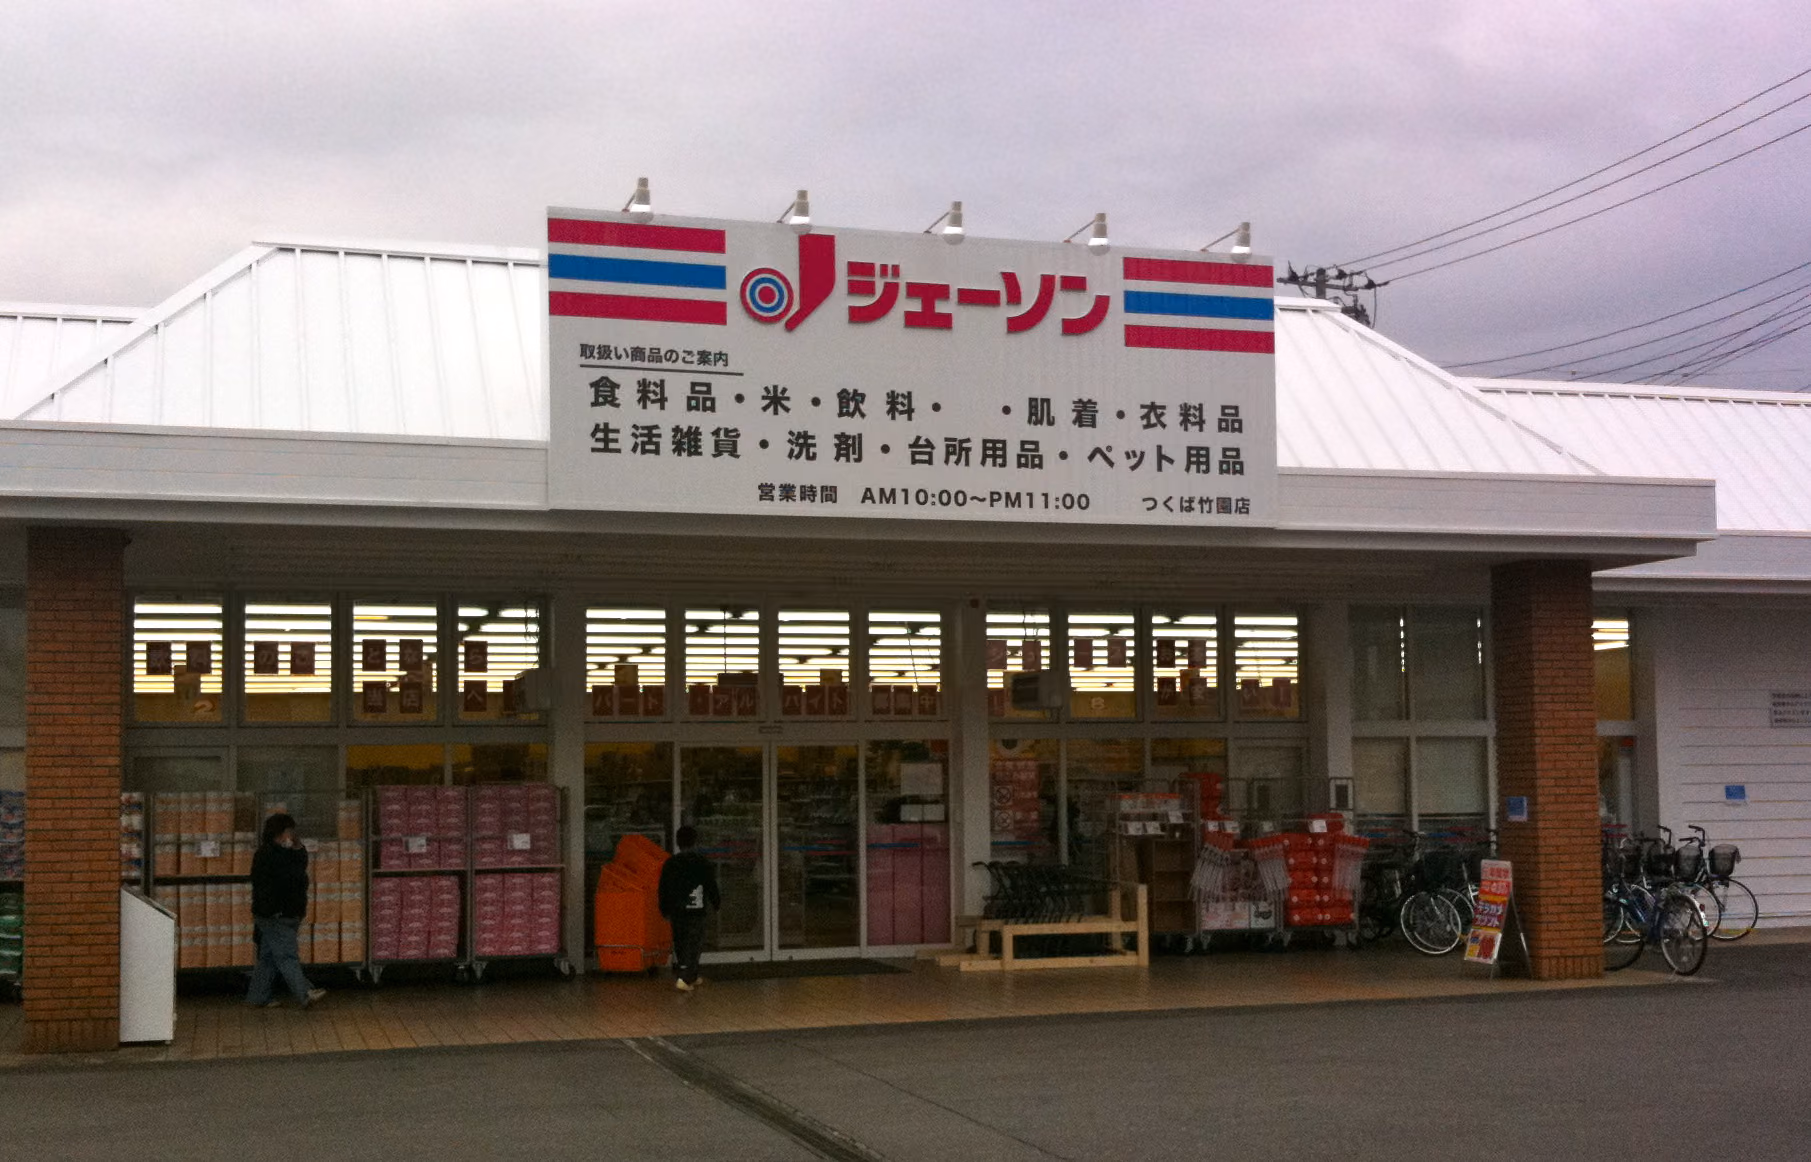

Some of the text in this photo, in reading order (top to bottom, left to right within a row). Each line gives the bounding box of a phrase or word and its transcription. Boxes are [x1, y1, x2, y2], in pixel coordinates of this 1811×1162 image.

[846, 260, 1111, 336] ジェーソン
[579, 343, 729, 367] 取扱い商品のご案内
[757, 483, 838, 504] 営業時間
[1141, 495, 1251, 515] つくば竹園店
